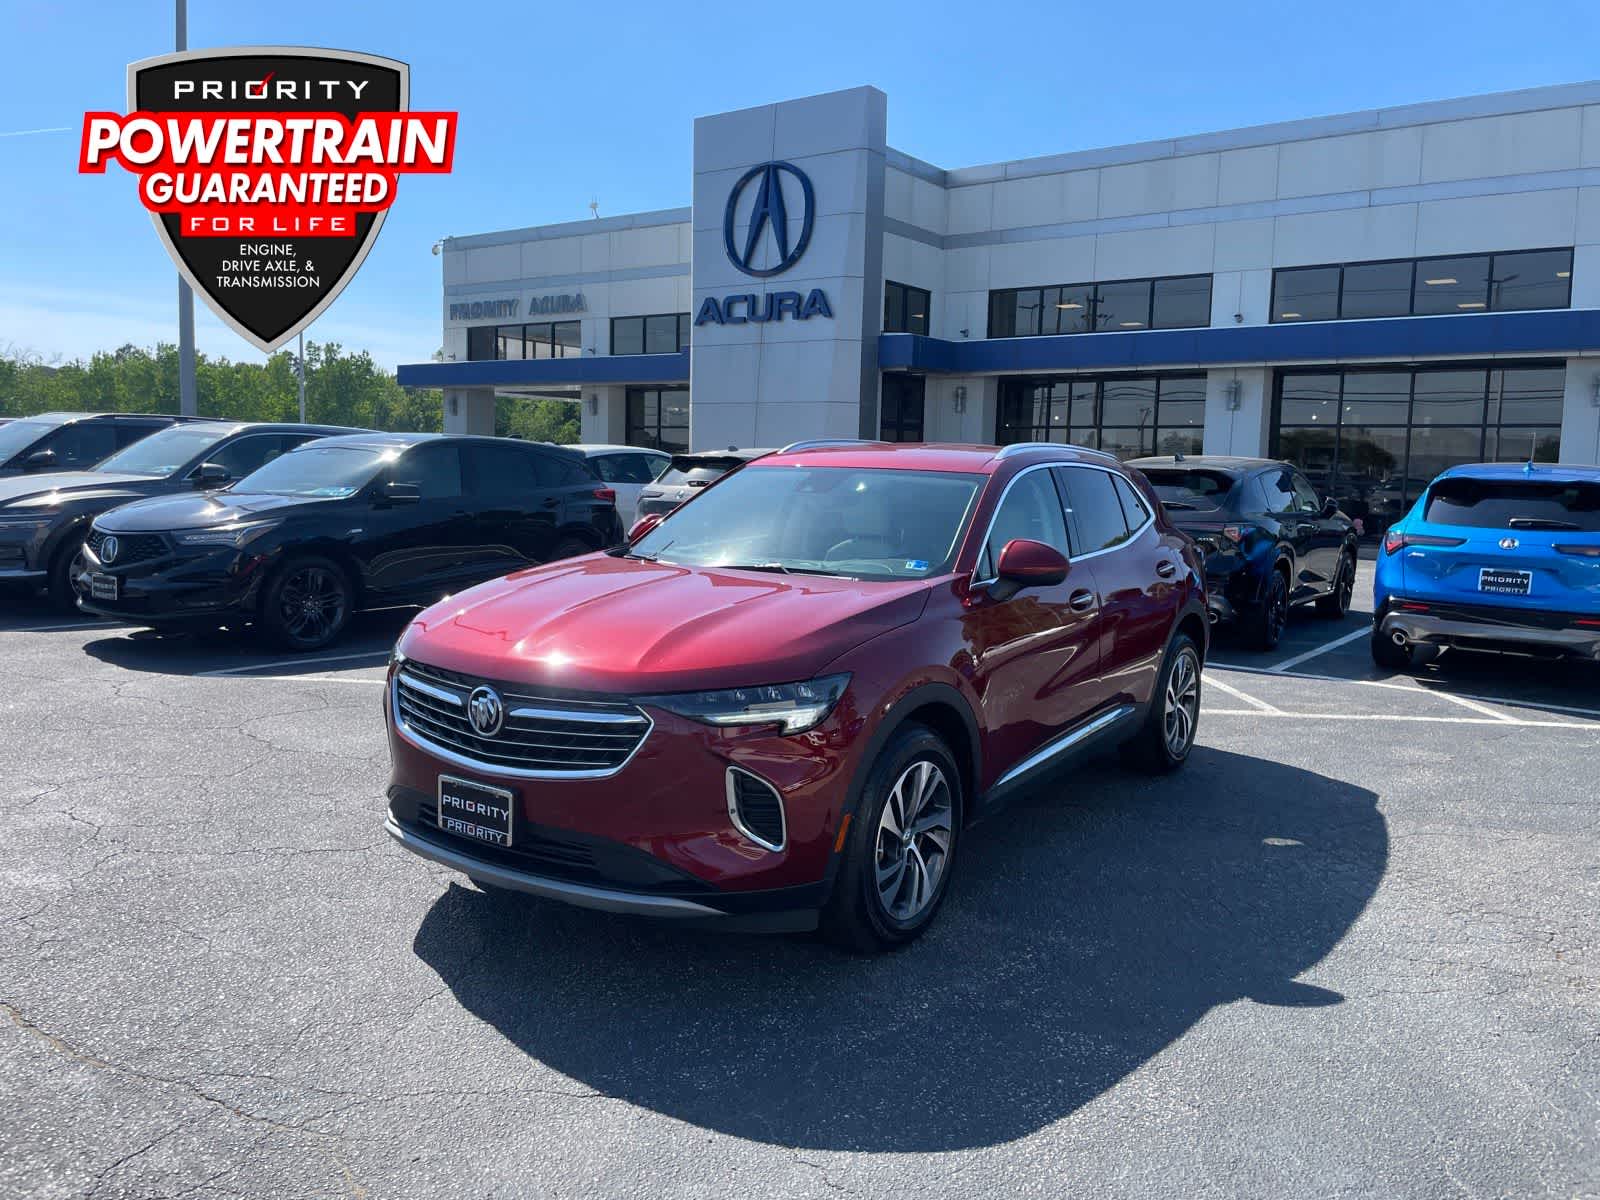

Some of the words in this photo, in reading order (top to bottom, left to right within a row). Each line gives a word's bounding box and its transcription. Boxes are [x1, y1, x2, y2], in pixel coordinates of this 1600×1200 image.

[694, 288, 833, 326] ACURA
[442, 794, 510, 821] PRIORITY
[447, 819, 503, 843] PRIORITY
